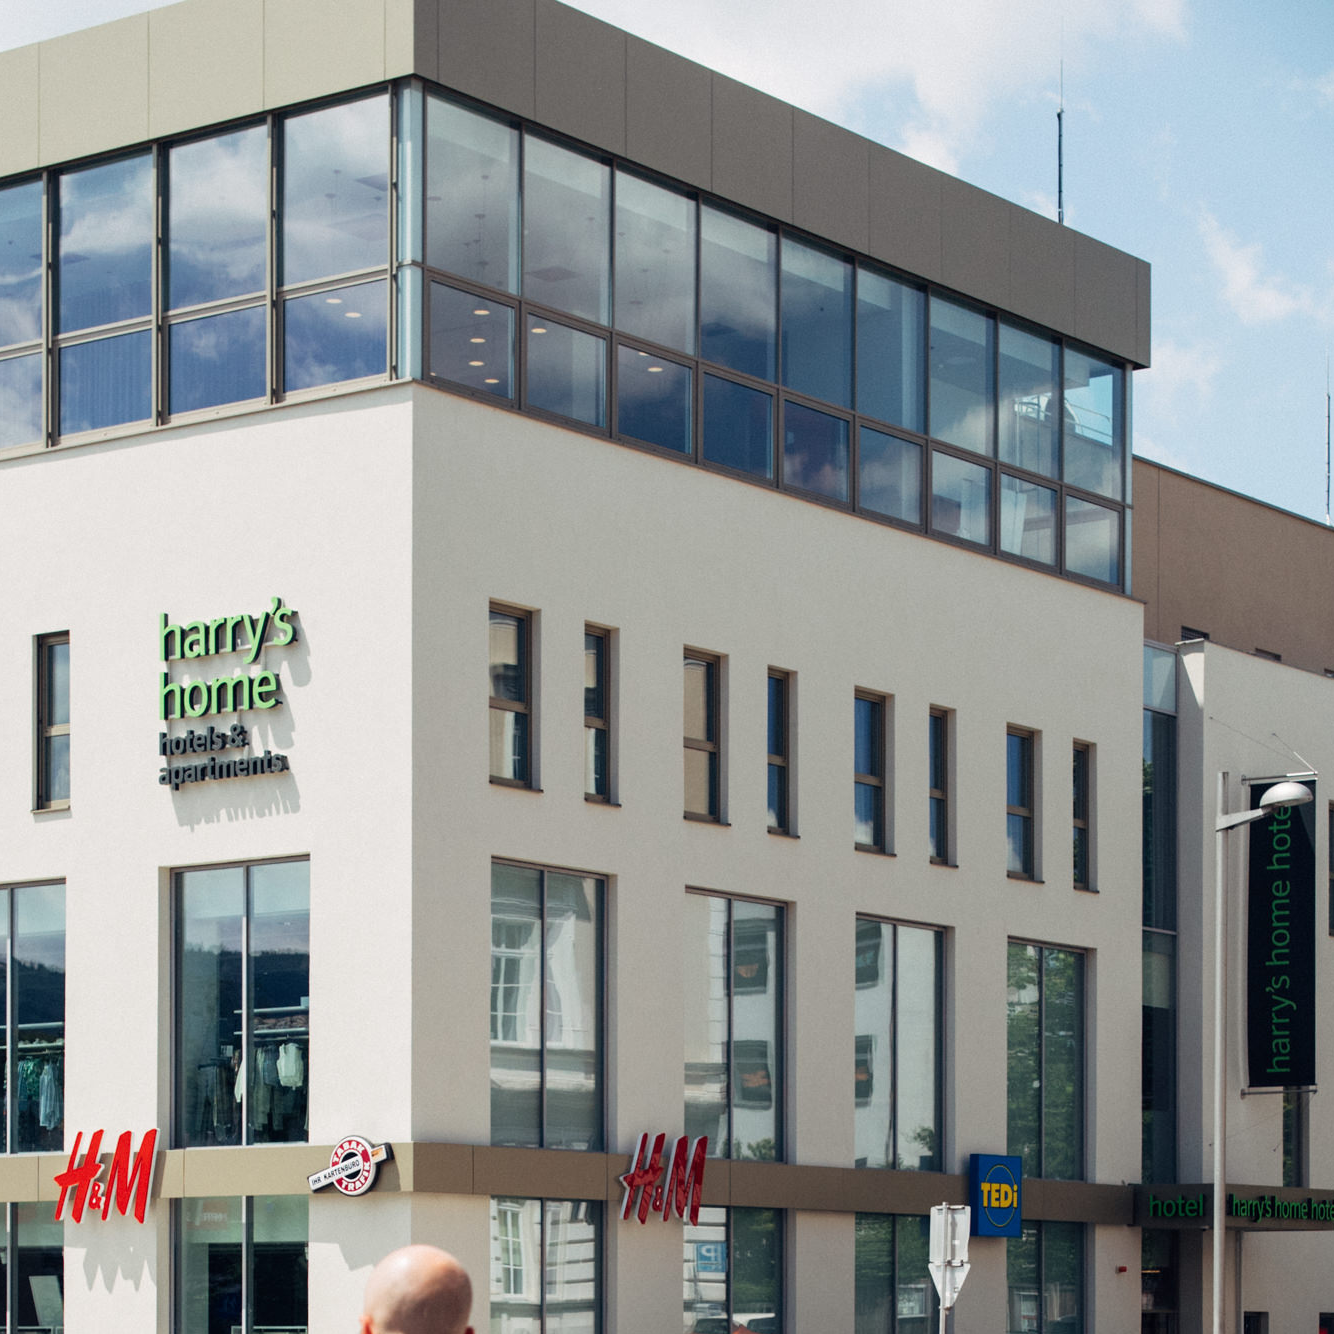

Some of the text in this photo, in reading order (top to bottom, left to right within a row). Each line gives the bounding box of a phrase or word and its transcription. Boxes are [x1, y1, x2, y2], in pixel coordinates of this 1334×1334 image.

[160, 596, 298, 664] harry's
[160, 670, 283, 720] home
[159, 723, 249, 756] hotels &
[159, 750, 289, 791] apartments
[1266, 805, 1297, 1073] harry's home hote
[332, 1141, 365, 1164] TABAK
[54, 1128, 160, 1224] H&M
[311, 1176, 322, 1186] IHR
[341, 1161, 371, 1192] TRAFIK
[619, 1132, 708, 1226] H&M
[980, 1182, 1018, 1208] TEDi
[1149, 1193, 1204, 1217] hotel
[1231, 1193, 1272, 1223] harry's
[1274, 1195, 1308, 1220] home
